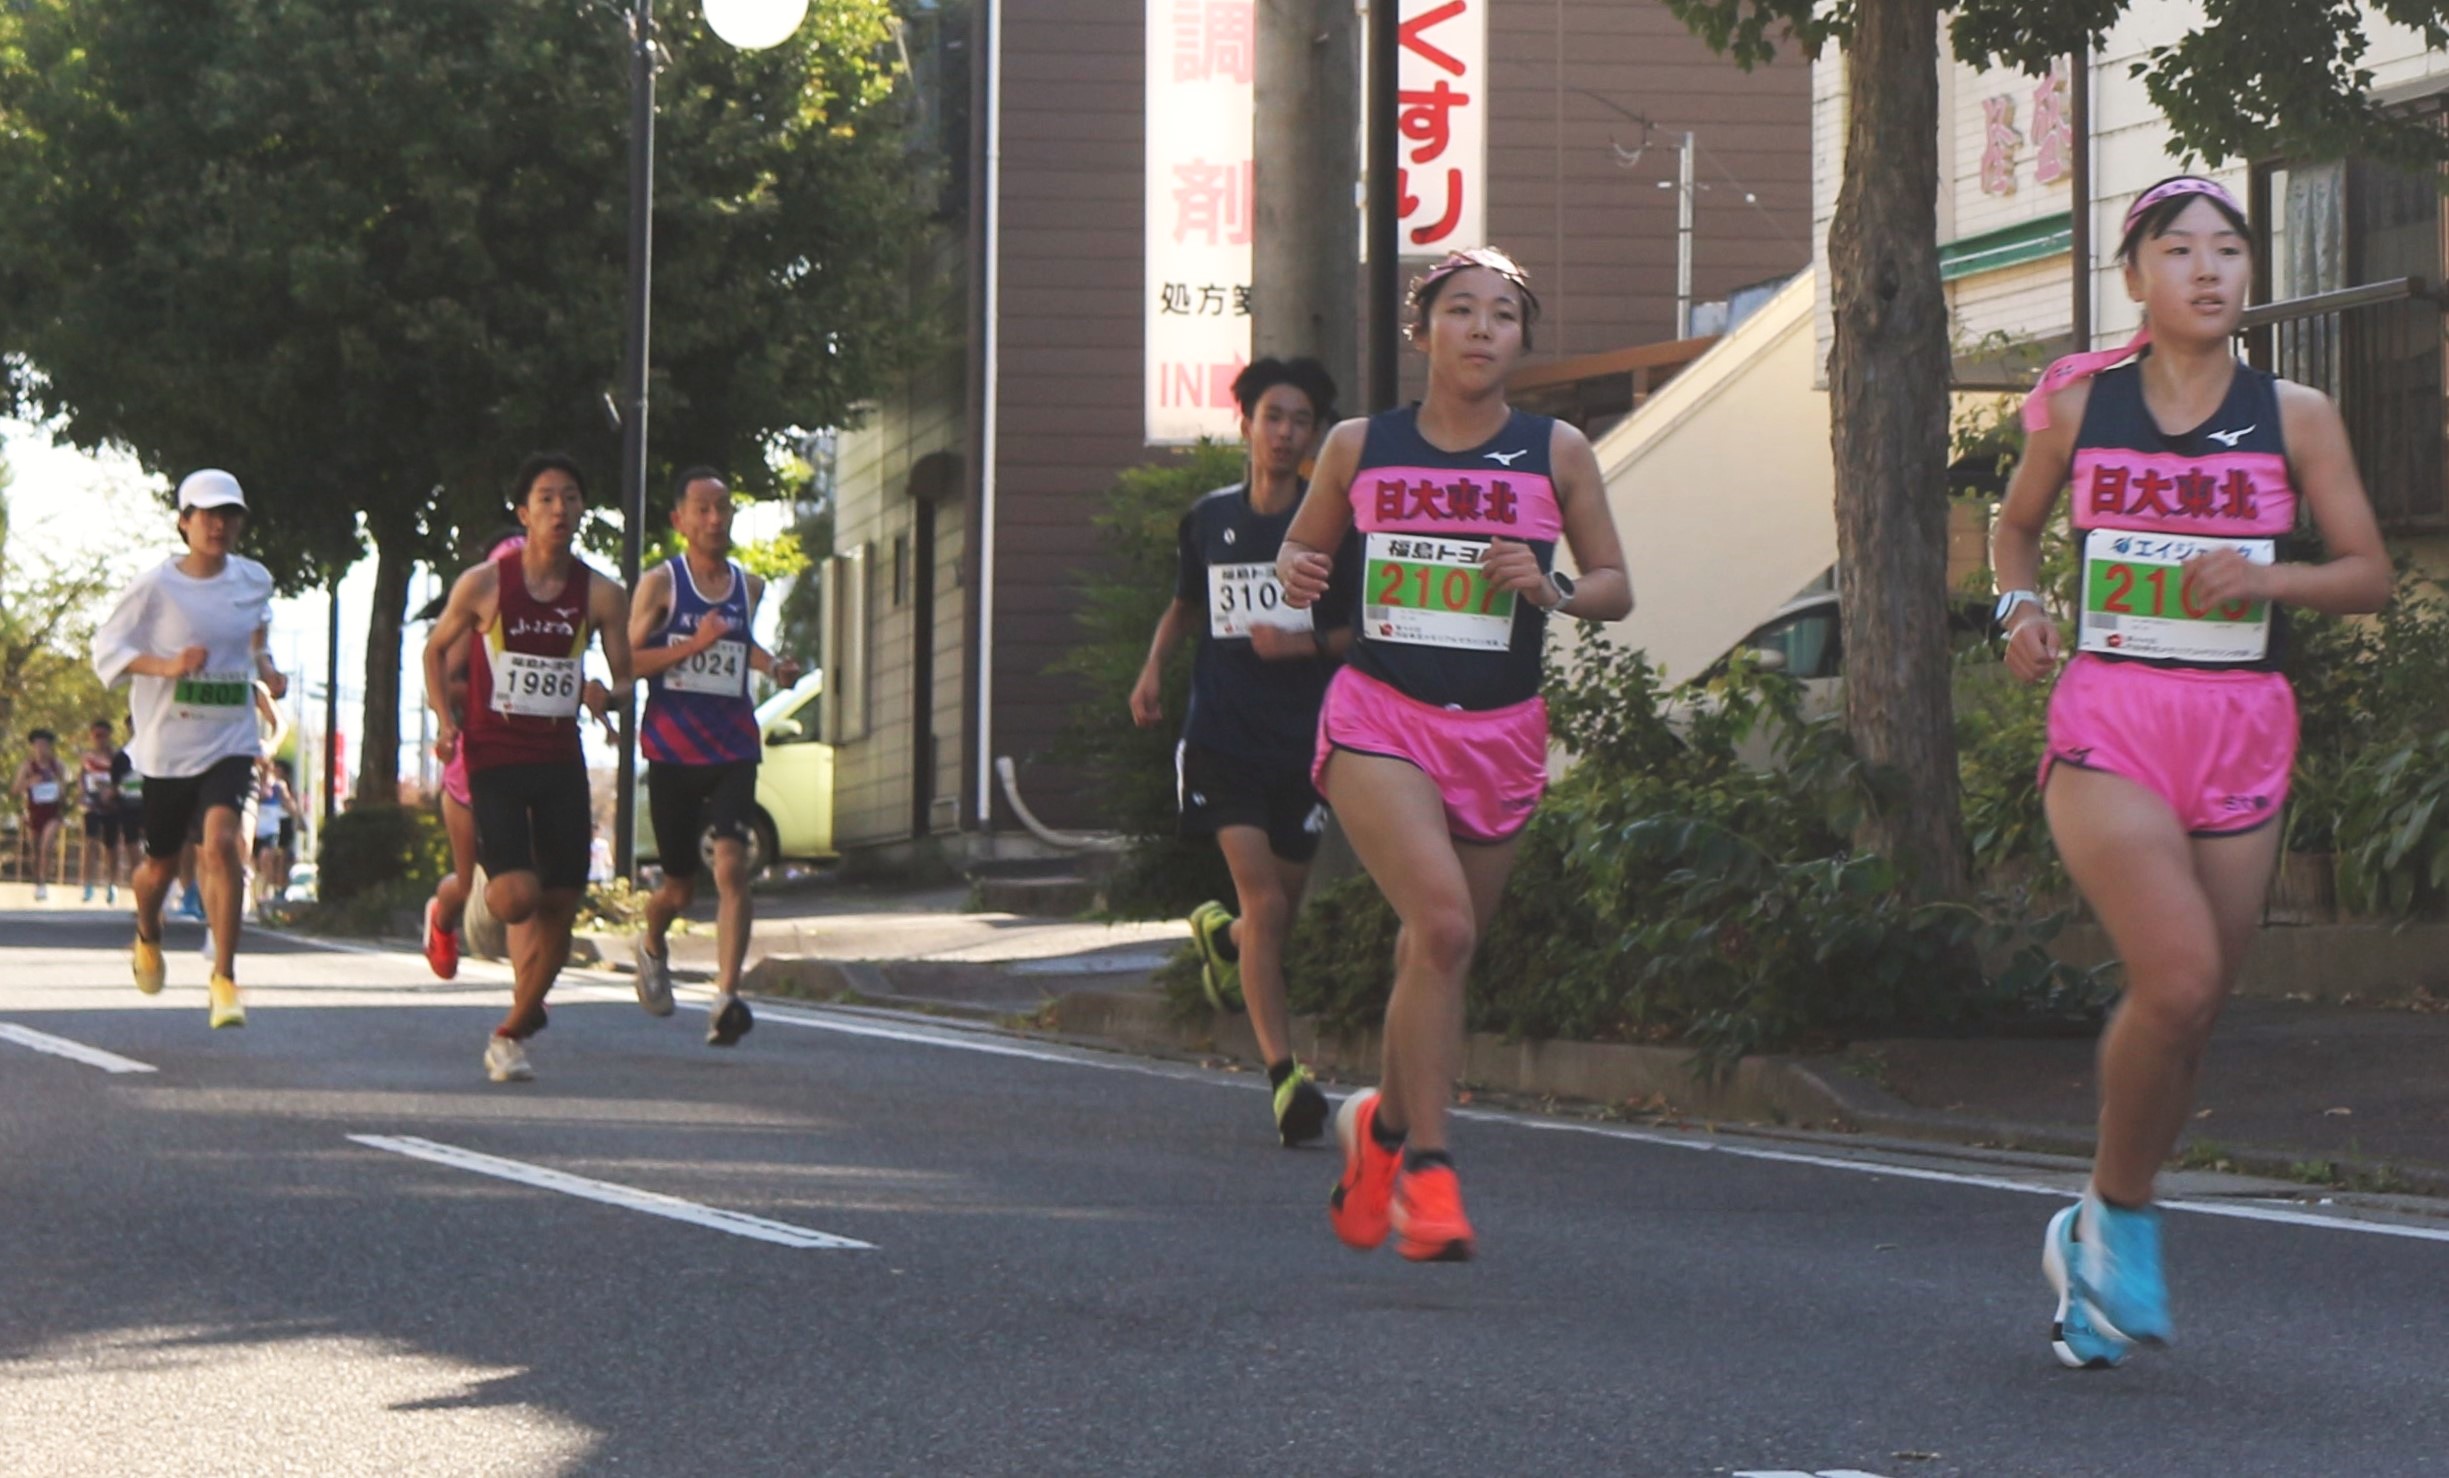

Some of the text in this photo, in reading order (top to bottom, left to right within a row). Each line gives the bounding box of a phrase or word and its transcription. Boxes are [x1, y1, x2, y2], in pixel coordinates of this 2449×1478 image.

[1172, 0, 1254, 246] 調剤
[1399, 0, 1470, 244] くすり
[1161, 362, 1202, 407] IN
[1375, 478, 1518, 524] 日大東北
[2090, 465, 2258, 519] 日大東北
[1389, 540, 1487, 563] 福島トヨ
[2135, 539, 2252, 560] エイジク
[1220, 582, 1287, 612] 310
[676, 651, 737, 677] 024
[507, 669, 574, 697] 1986
